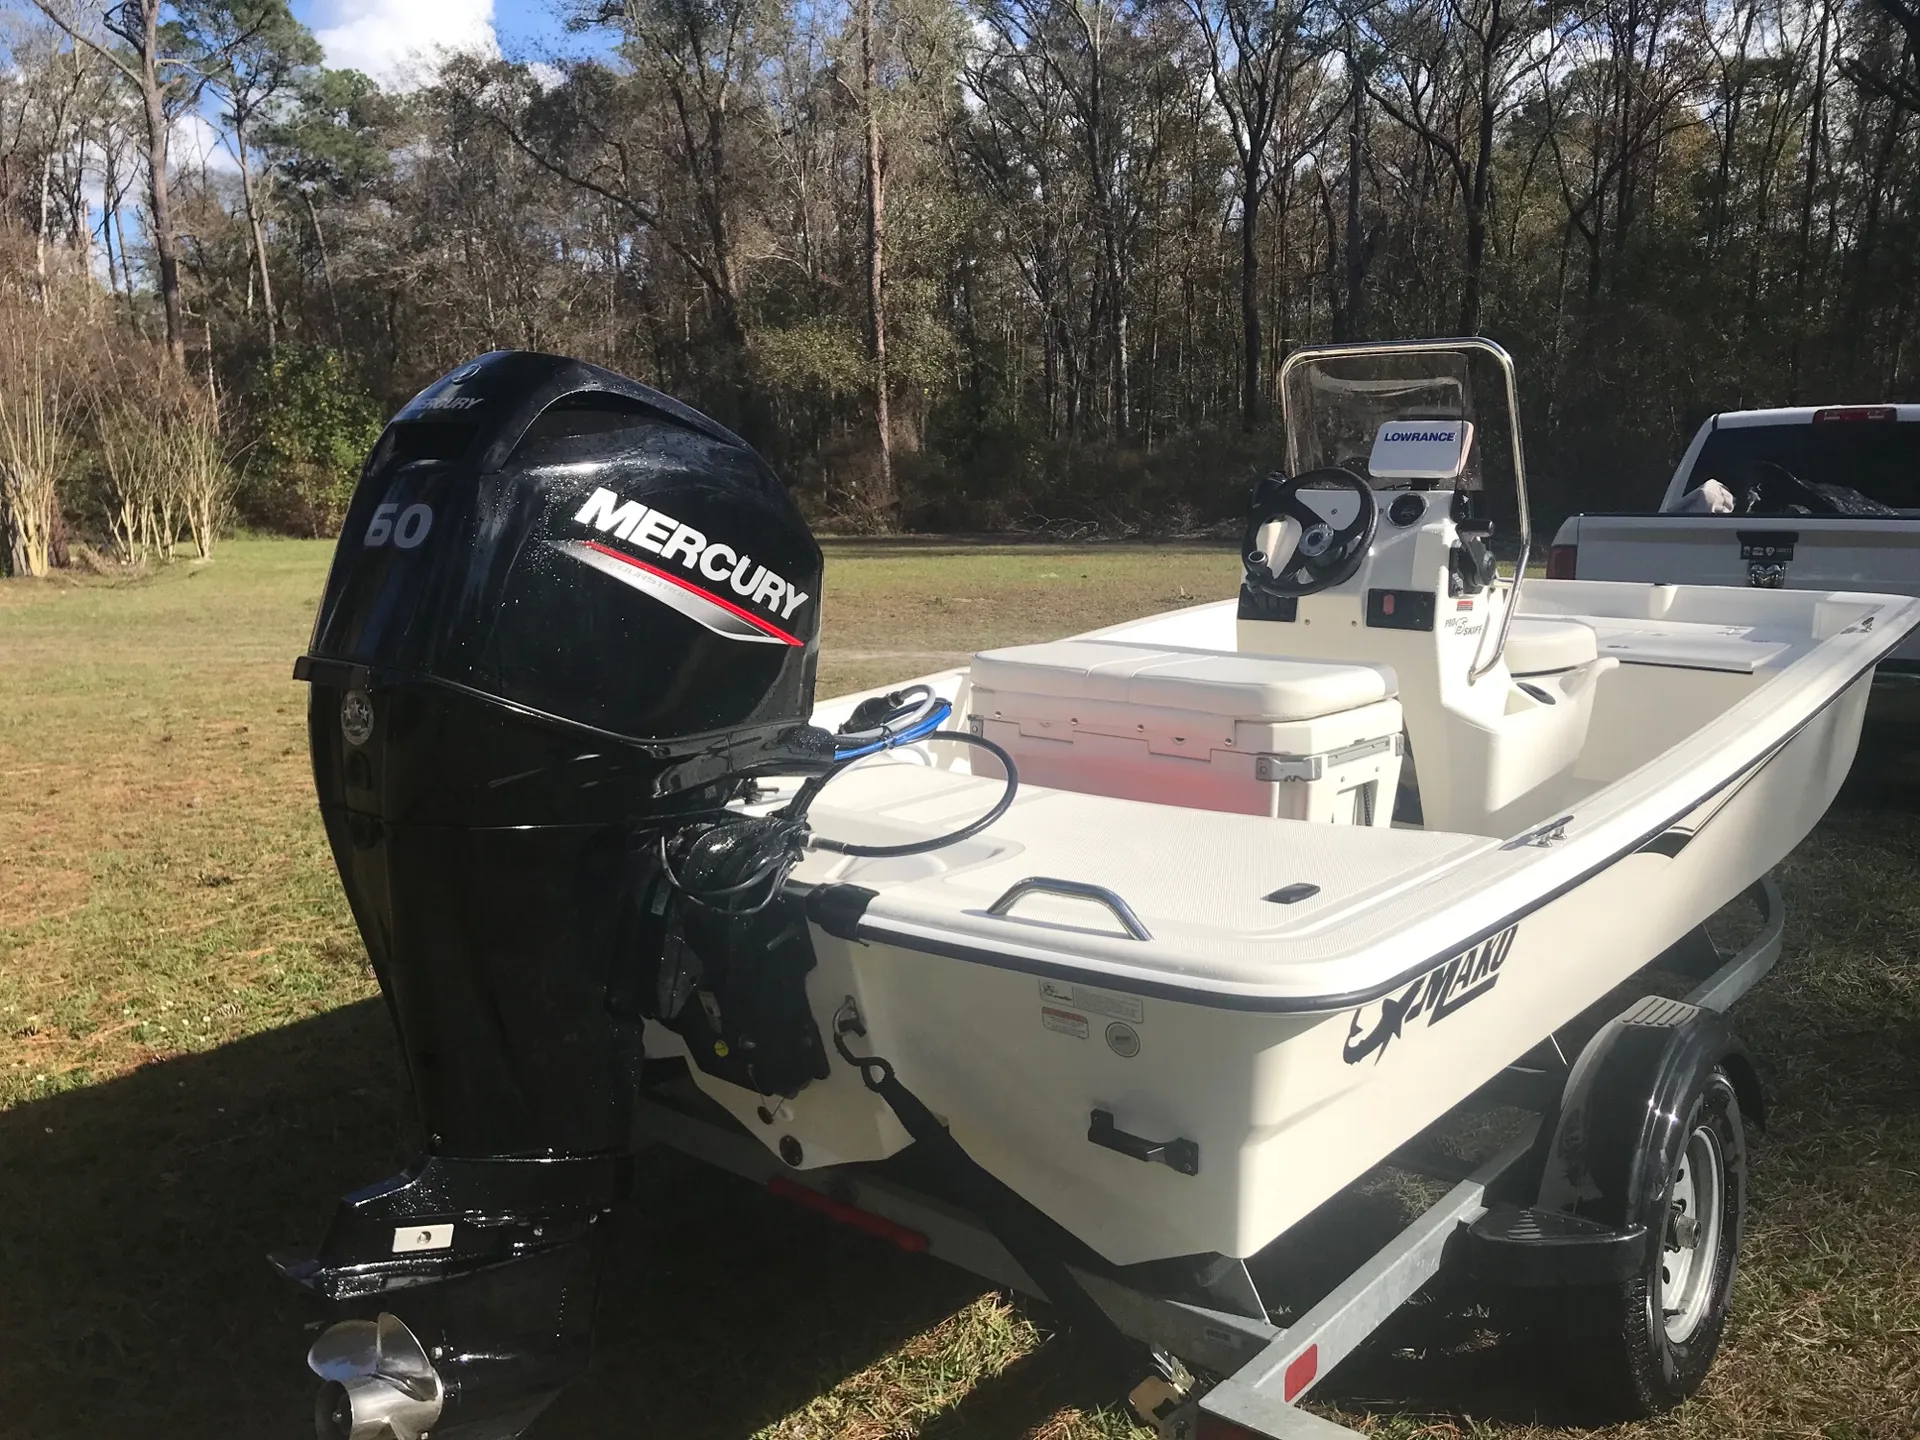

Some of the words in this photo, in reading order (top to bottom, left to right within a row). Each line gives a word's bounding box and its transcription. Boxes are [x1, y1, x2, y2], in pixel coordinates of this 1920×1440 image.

[1383, 432, 1456, 442] LOWRANCE
[364, 503, 433, 549] 60
[574, 486, 809, 620] MERCURY
[1404, 923, 1519, 1028] MAKO
